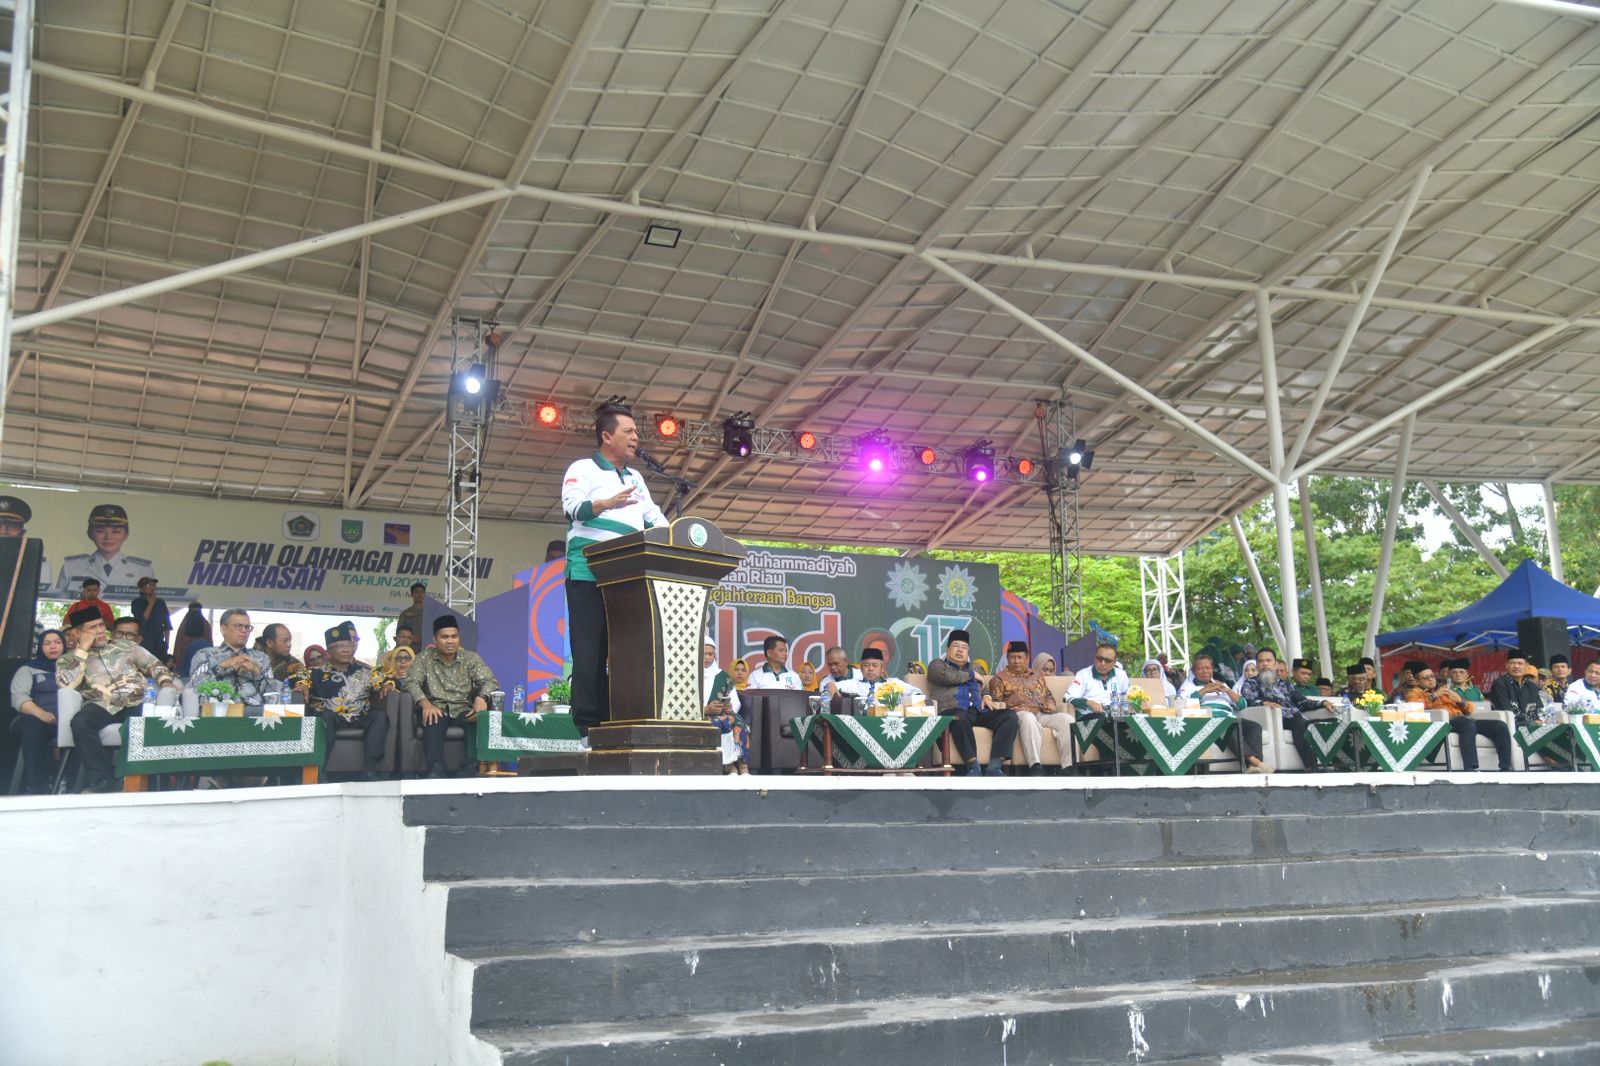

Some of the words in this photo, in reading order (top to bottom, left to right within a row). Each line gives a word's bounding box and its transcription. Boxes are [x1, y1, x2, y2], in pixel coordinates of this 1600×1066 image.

[194, 538, 275, 566] PEKAN
[277, 544, 393, 575] OLAHRAGA
[396, 552, 444, 577] DAN
[743, 553, 855, 576] Muhammadiyah
[187, 561, 327, 592] MADRASAH
[751, 570, 783, 585] Riau
[785, 588, 834, 610] Bangsa
